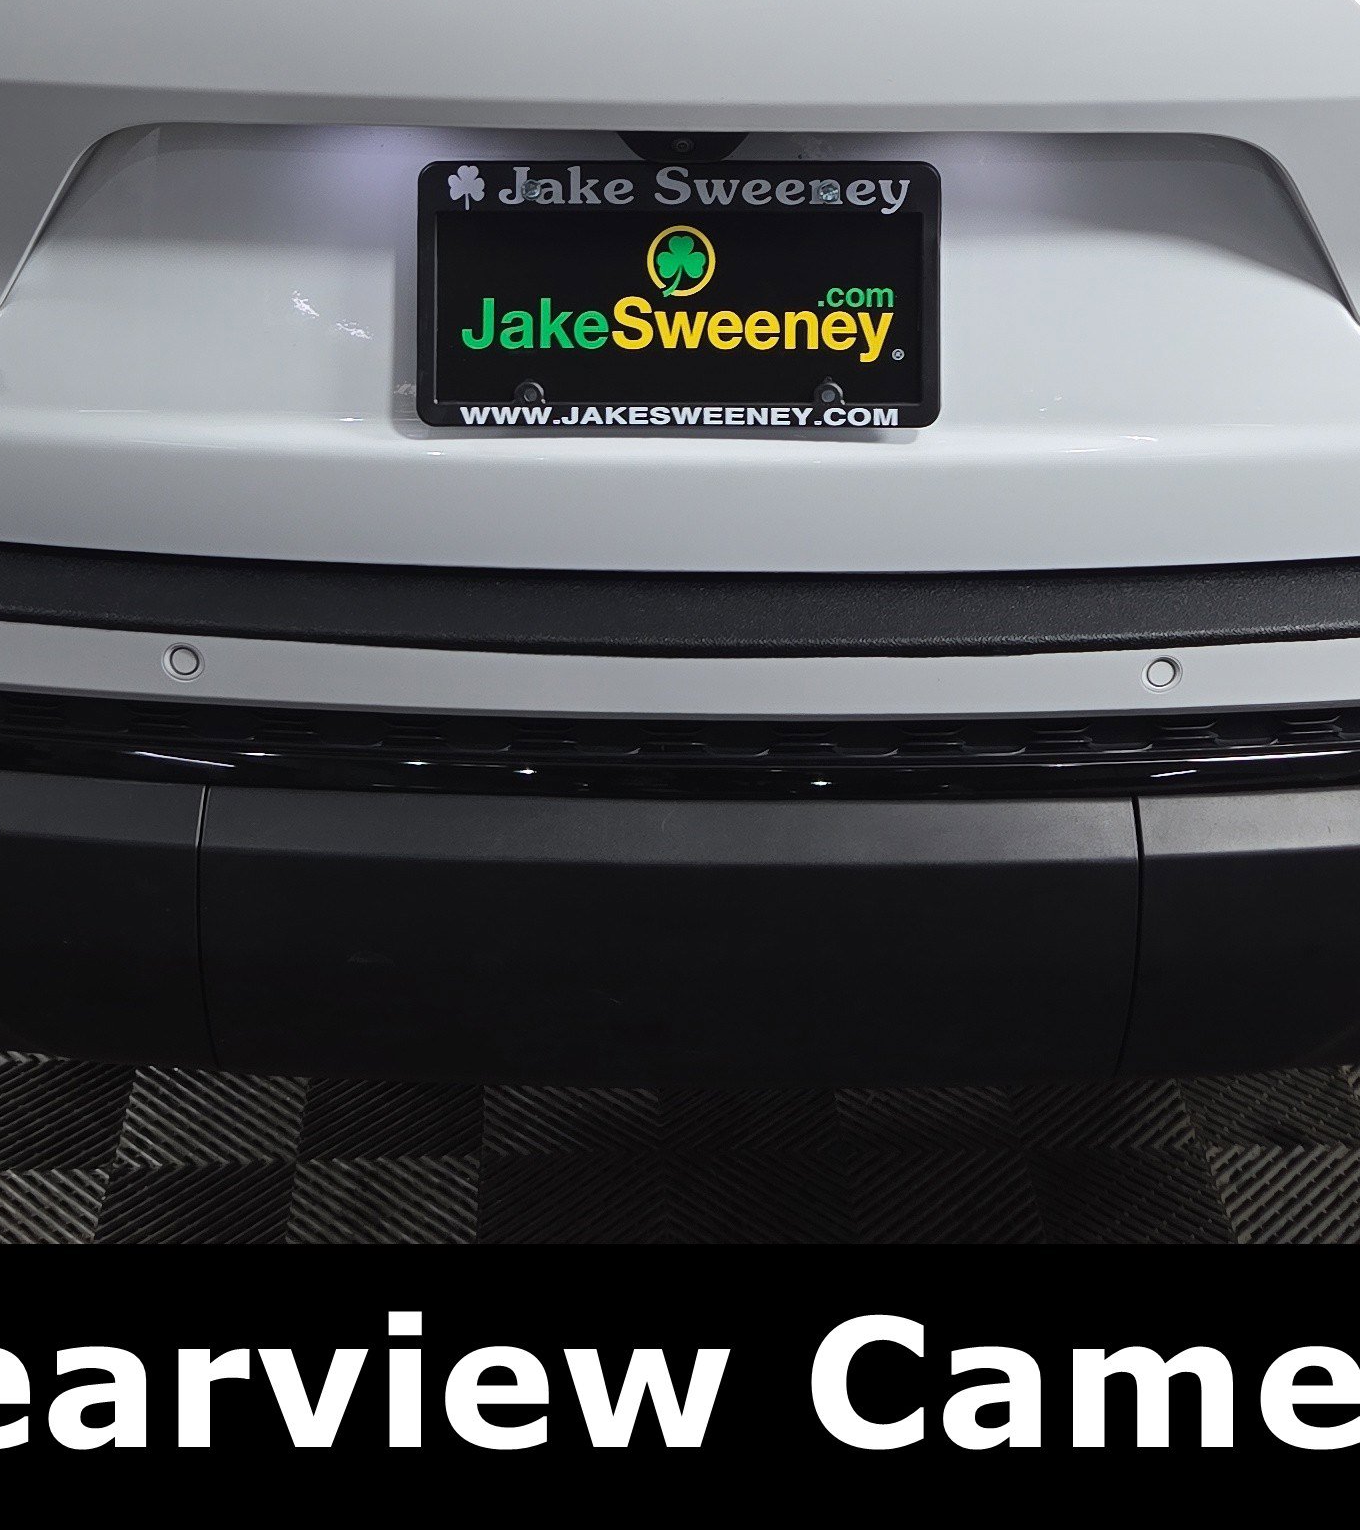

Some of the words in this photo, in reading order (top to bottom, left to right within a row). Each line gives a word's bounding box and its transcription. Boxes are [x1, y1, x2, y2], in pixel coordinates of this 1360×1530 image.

[498, 166, 635, 206] Jake
[654, 166, 910, 215] Sweeney
[817, 286, 895, 308] .com
[459, 405, 899, 427] WWW.JAKESWEENEY.COM
